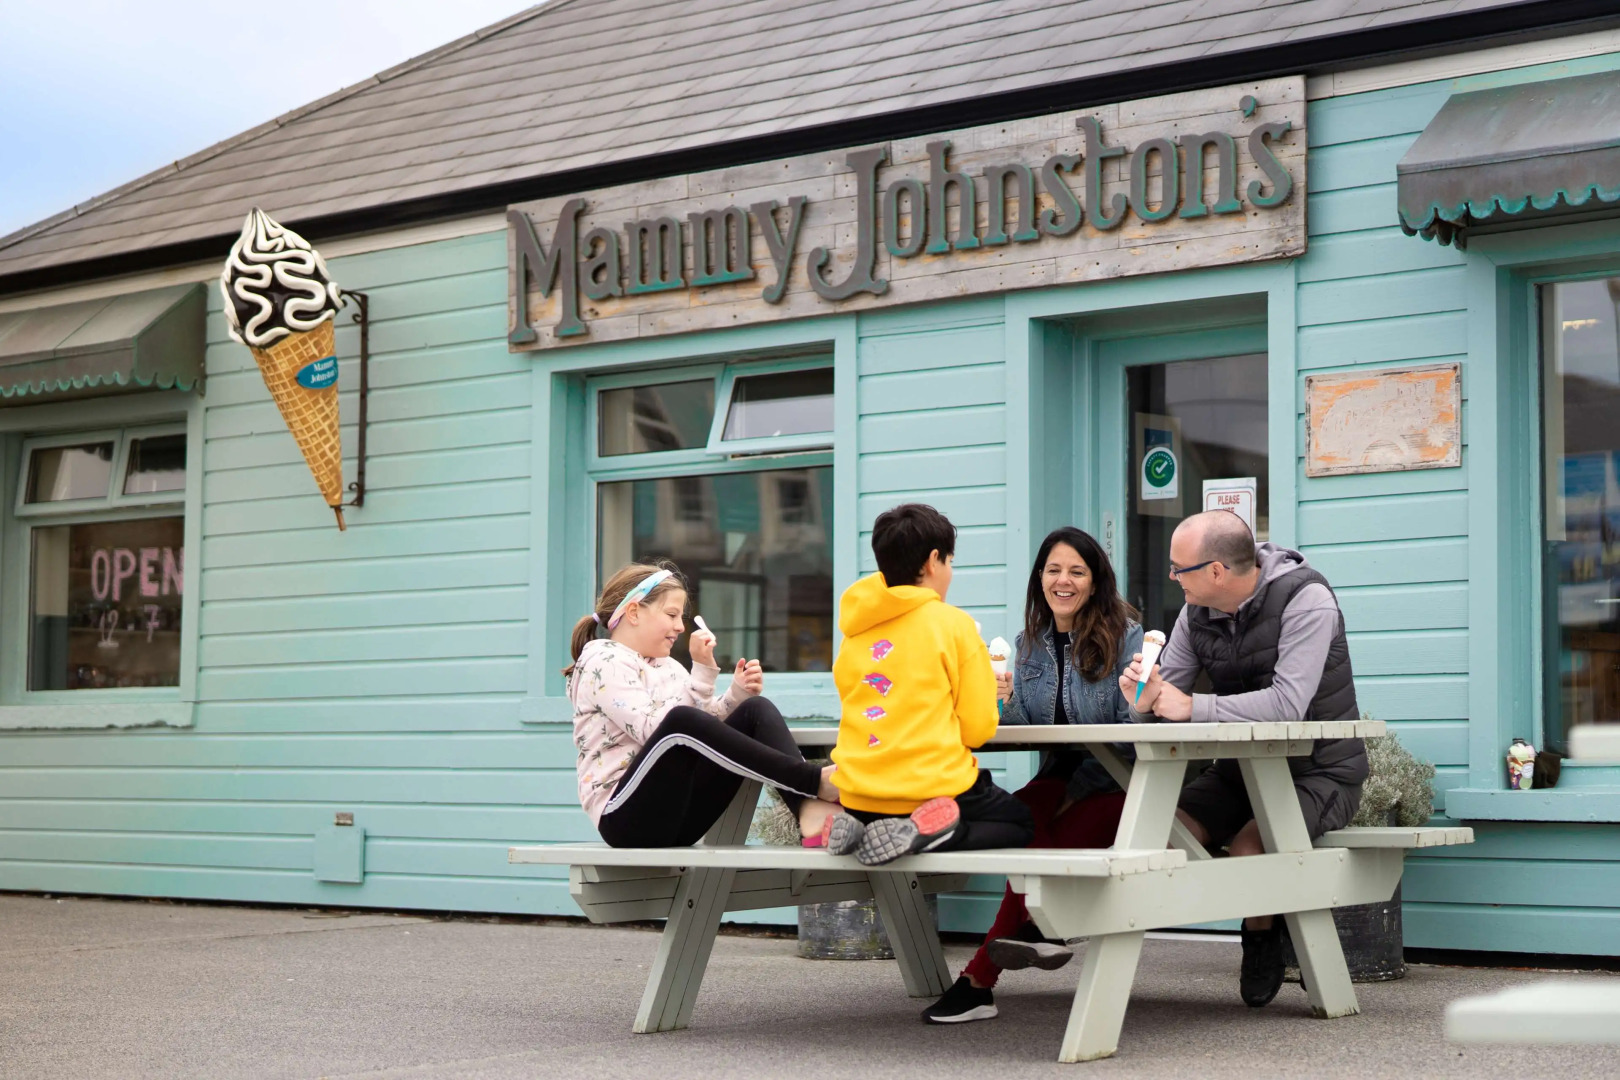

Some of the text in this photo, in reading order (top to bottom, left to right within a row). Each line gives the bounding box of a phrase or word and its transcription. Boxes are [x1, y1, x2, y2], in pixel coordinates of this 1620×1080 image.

[507, 95, 1295, 345] Mammy Johnston's
[1217, 494, 1240, 505] PLEASE
[91, 547, 184, 602] OPEN
